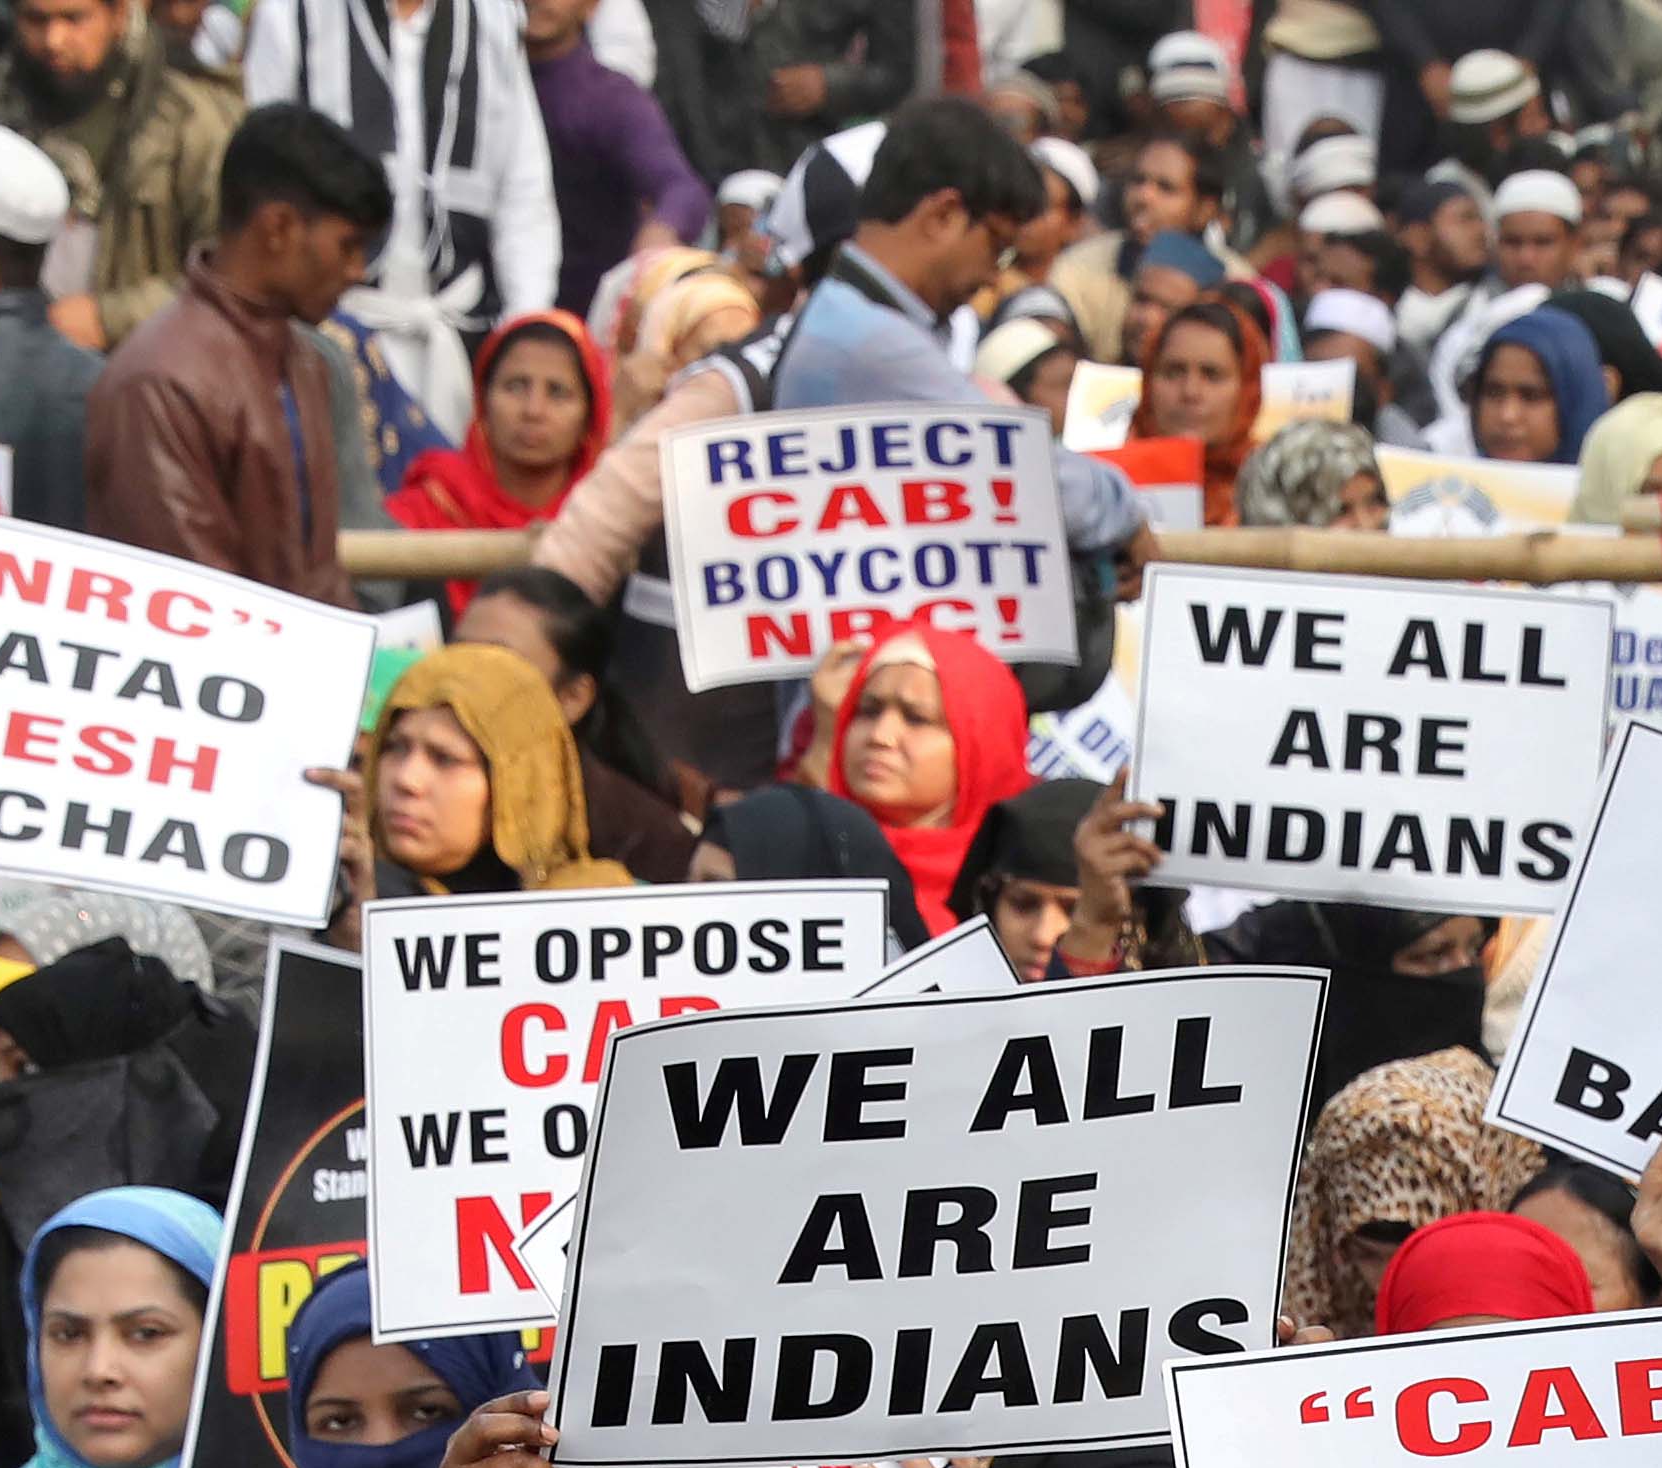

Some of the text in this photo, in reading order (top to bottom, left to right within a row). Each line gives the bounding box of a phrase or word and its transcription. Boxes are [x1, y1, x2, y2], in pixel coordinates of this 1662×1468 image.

[707, 421, 1026, 485] REJECT
[726, 478, 1018, 540] CAB!
[703, 542, 1049, 606] BOYCOTT
[1188, 603, 1569, 689] WE ALL
[1267, 708, 1471, 779] ARE
[1153, 798, 1575, 884] INDIANS
[392, 916, 847, 992] WE OPPOSE
[660, 1045, 915, 1151] WE
[967, 1016, 1245, 1134] ALL
[400, 1106, 510, 1169] WE
[776, 1171, 1099, 1286] ARE
[588, 1295, 1252, 1428] INDIANS
